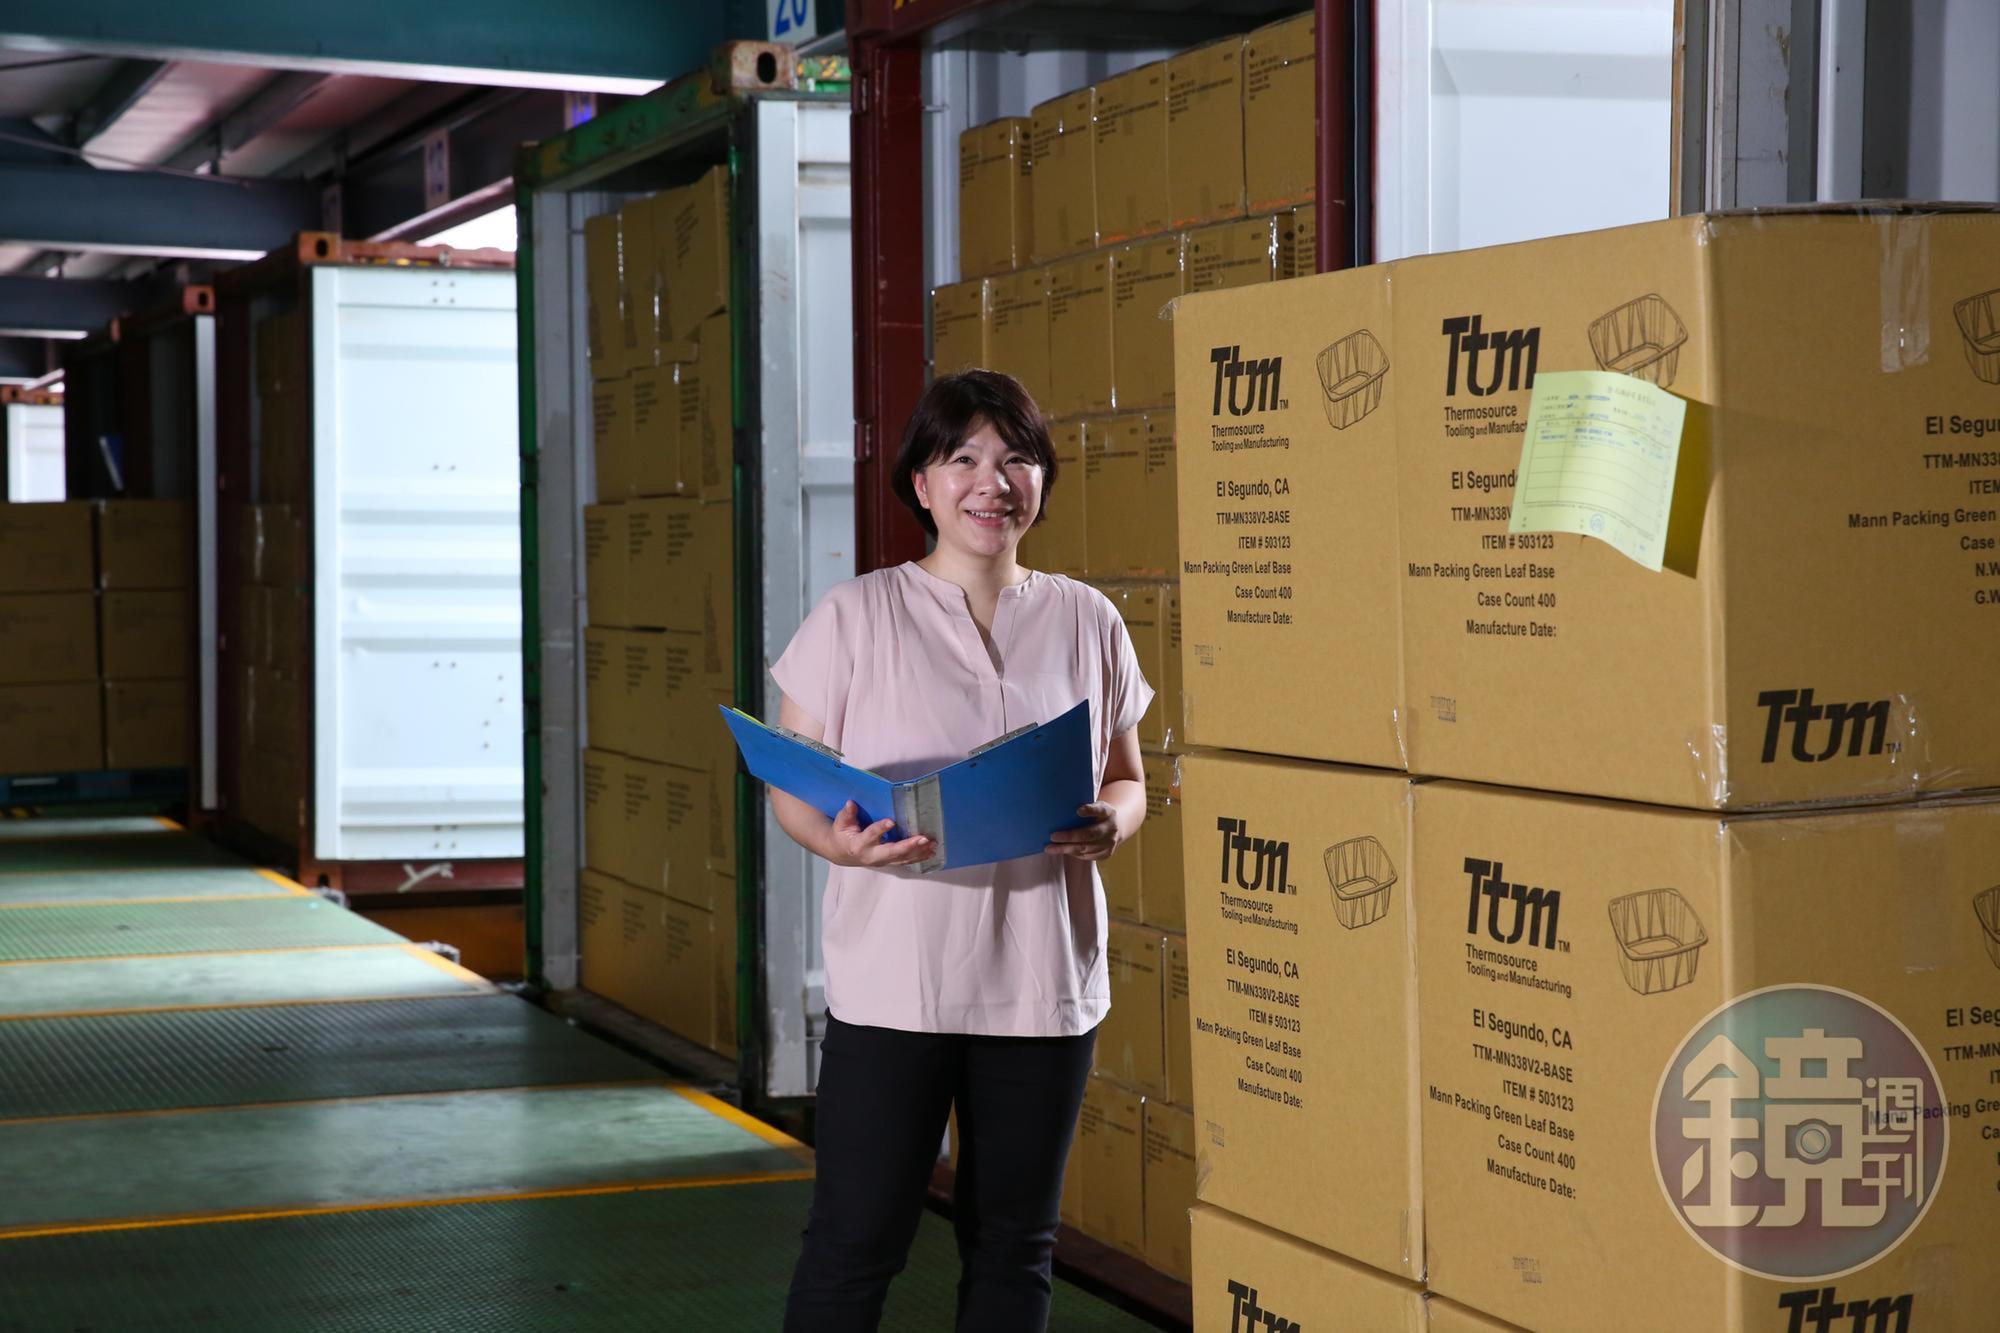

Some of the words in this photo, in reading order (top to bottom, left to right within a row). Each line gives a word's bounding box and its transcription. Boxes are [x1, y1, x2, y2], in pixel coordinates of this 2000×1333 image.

[1442, 314, 1541, 397] Ttm
[1210, 345, 1282, 416] Ttm
[1445, 405, 1518, 421] Thermosource
[1212, 424, 1265, 438] Thermosource
[1445, 424, 1475, 439] Tooling
[1476, 425, 1488, 436] and
[1926, 416, 1943, 435] El
[1212, 440, 1234, 453] Tooling
[1243, 436, 1290, 450] Manufacturing
[1923, 452, 2000, 469] TTM-MN33
[1217, 481, 1225, 497] El
[1228, 480, 1272, 500] Segundo,
[1275, 478, 1290, 495] CA
[1452, 472, 1463, 489] El
[1468, 470, 1519, 493] Segund
[1217, 511, 1290, 525] TTM-MN338V2-BASE
[1849, 513, 1888, 528] Mann
[1892, 511, 1950, 528] Packing
[1955, 509, 1996, 523] Green
[1239, 536, 1257, 549] ITEM
[1258, 537, 1263, 548] #
[1265, 536, 1291, 549] 503123
[1482, 535, 1506, 550] ITEM
[1510, 536, 1516, 548] #
[1519, 535, 1554, 550] 503123
[1961, 536, 1995, 551] Case
[1184, 561, 1201, 574] Mann
[1203, 561, 1230, 577] Packing
[1232, 562, 1252, 574] Green
[1255, 562, 1271, 574] Leaf
[1273, 562, 1291, 574] Base
[1409, 564, 1432, 577] Mann
[1434, 563, 1470, 581] Packing
[1473, 563, 1501, 578] Green
[1505, 563, 1527, 578] Leaf
[1530, 564, 1555, 579] Base
[1236, 586, 1252, 599] Case
[1255, 586, 1277, 599] Count
[1279, 587, 1292, 600] 400
[1478, 592, 1501, 607] Case
[1505, 593, 1535, 607] Count
[1538, 593, 1556, 608] 400
[1228, 610, 1271, 624] Manufacture
[1273, 612, 1293, 625] Date:
[1467, 620, 1527, 636] Manufacture
[1530, 622, 1557, 637] Date:
[1758, 688, 1891, 764] Ttm
[1218, 817, 1290, 893] Ttm
[1221, 892, 1273, 914] Thermosource
[1464, 857, 1561, 950] Ttm
[1221, 907, 1243, 924] Tooling
[1243, 914, 1252, 924] and
[1252, 913, 1298, 935] Manufacturing
[1227, 948, 1235, 965] El
[1238, 950, 1282, 978] Segundo,
[1284, 961, 1299, 979] CA
[1465, 943, 1537, 972] Thermosource
[1466, 961, 1496, 982] Tooling
[1496, 971, 1509, 982] and
[1509, 970, 1572, 999] Manufacturing
[1227, 979, 1300, 1008] TTM-MN338V2-BASE
[1249, 1008, 1267, 1025] ITEM
[1268, 1014, 1273, 1025] #
[1275, 1015, 1301, 1033] 503123
[1947, 1008, 1964, 1028] El
[1197, 1017, 1213, 1032] Mann
[1215, 1023, 1241, 1044] Packing
[1243, 1031, 1264, 1048] Green
[1266, 1037, 1281, 1052] Leaf
[1283, 1041, 1301, 1058] Base
[1473, 1009, 1485, 1028] El
[1489, 1013, 1548, 1048] Segundo,
[1552, 1028, 1573, 1050] CA
[1246, 1056, 1264, 1072] Case
[1266, 1062, 1287, 1079] Count
[1289, 1067, 1303, 1084] 400
[1473, 1044, 1573, 1083] TTM-MN338V2-BASE
[1238, 1078, 1282, 1103] Manufacture
[1284, 1091, 1303, 1109] Date:
[1503, 1080, 1527, 1101] ITEM
[1530, 1087, 1536, 1101] #
[1539, 1090, 1574, 1112] 503123
[1430, 1085, 1452, 1106] Mann
[1455, 1093, 1491, 1120] Packing
[1494, 1105, 1522, 1126] Green
[1525, 1114, 1547, 1134] Leaf
[1550, 1122, 1575, 1142] Base
[1914, 1102, 1971, 1120] Packing
[1498, 1134, 1522, 1154] Case
[1525, 1142, 1555, 1165] Count
[1557, 1151, 1576, 1170] 400
[1487, 1158, 1547, 1190] Manufacture
[1550, 1178, 1576, 1200] Date:
